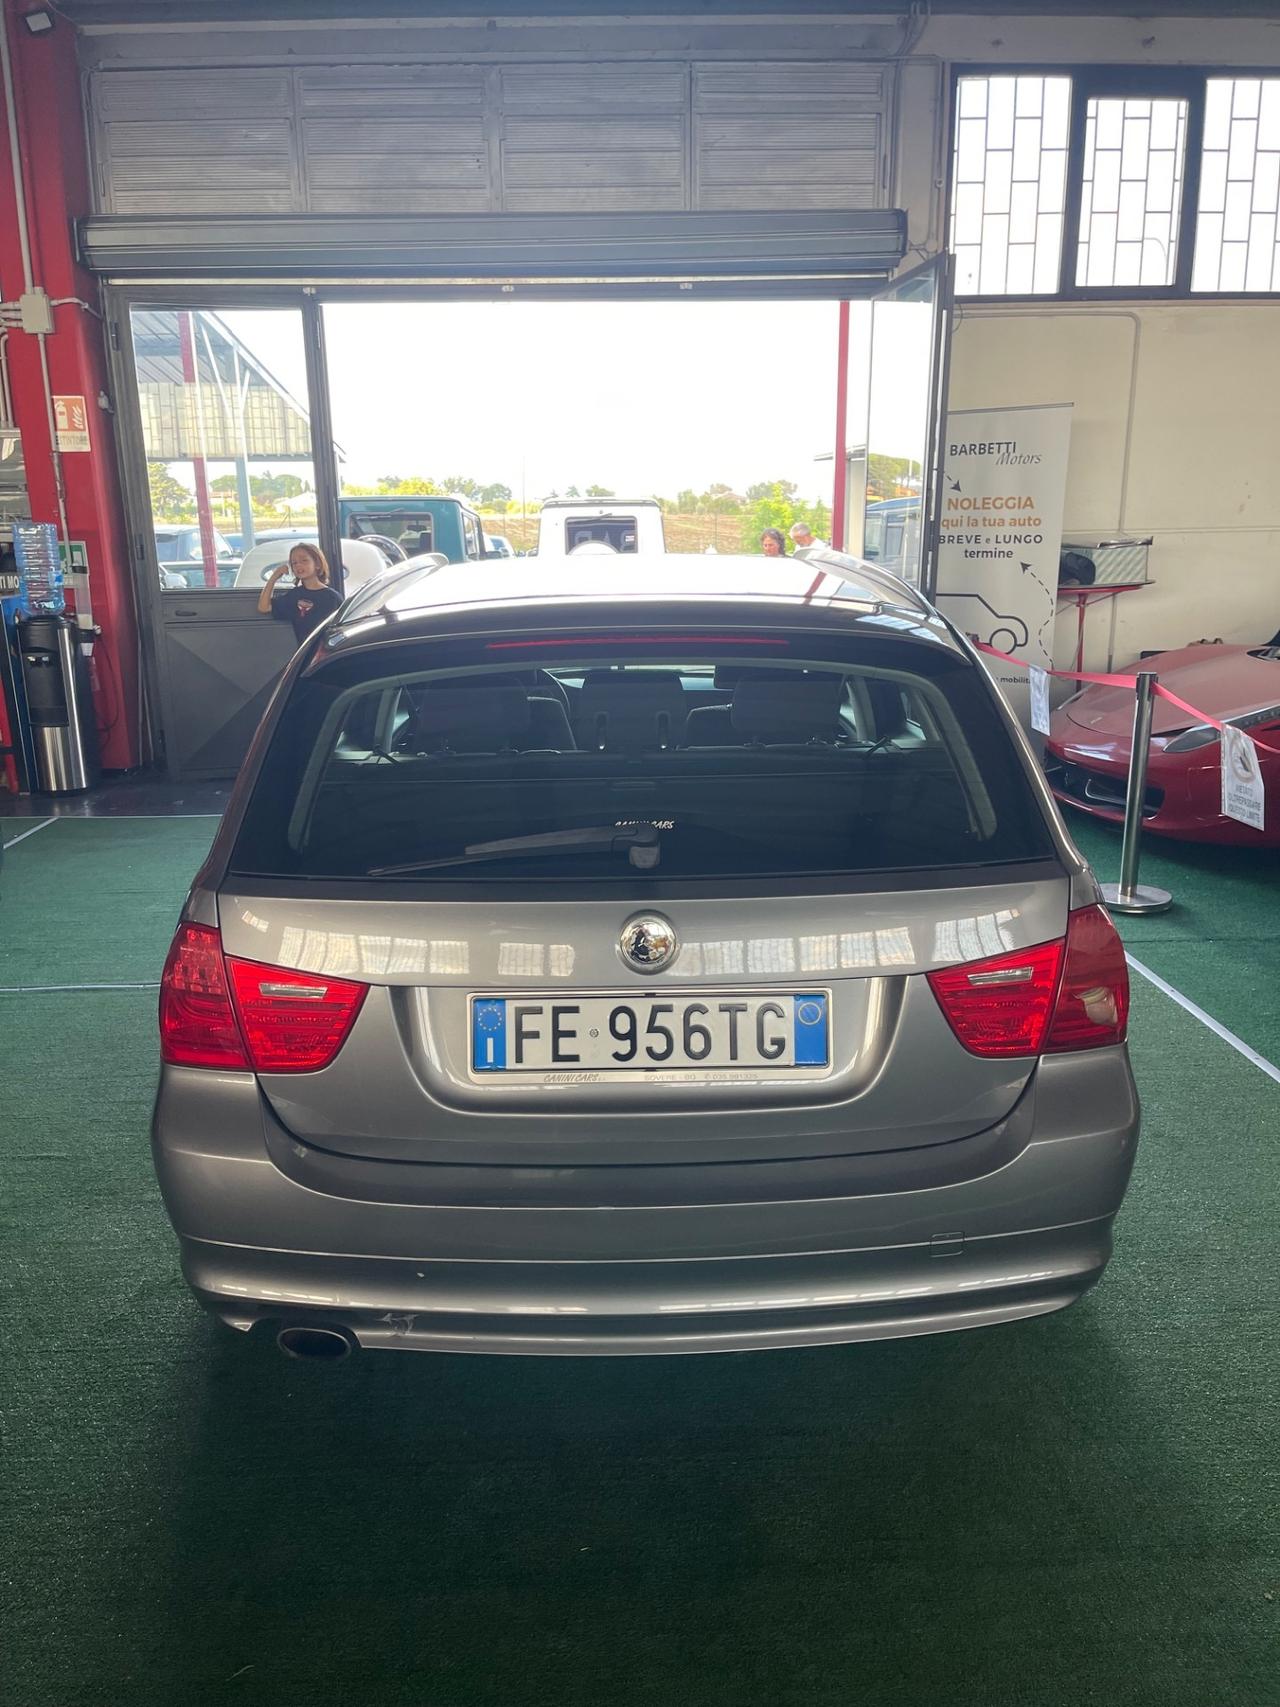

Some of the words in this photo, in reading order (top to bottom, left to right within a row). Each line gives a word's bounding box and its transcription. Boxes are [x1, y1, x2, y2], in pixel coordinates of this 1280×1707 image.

[950, 442, 1016, 456] BARBETTI
[996, 453, 1042, 465] Motors
[947, 496, 1035, 511] NOLEGGIA
[941, 515, 964, 529] qui
[967, 516, 978, 527] la
[982, 516, 1005, 527] tua
[1008, 516, 1042, 527] auto
[939, 534, 982, 544] BREVE
[995, 534, 1043, 544] LUNGO
[964, 547, 1014, 559] termine
[1000, 676, 1030, 684] mobilit
[514, 1005, 581, 1064] FE
[608, 1002, 786, 1062] 956TG
